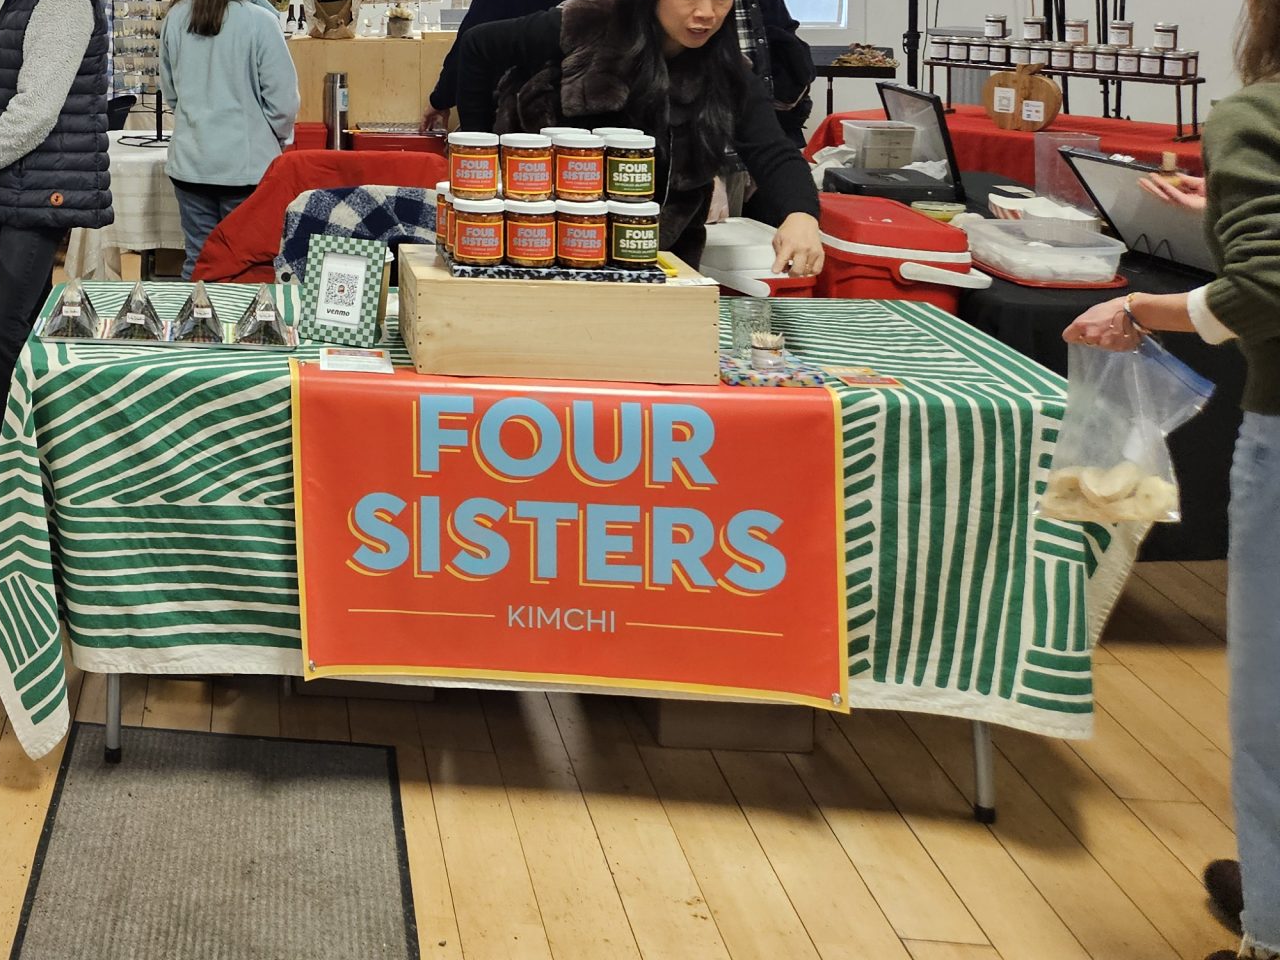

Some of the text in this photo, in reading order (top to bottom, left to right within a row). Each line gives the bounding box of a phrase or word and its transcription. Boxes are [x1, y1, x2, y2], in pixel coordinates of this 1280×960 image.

[461, 160, 489, 169] FOUR
[519, 162, 545, 172] FOUR
[568, 161, 596, 170] FOUR
[619, 164, 648, 172] FOUR
[456, 169, 493, 179] SISTERS
[513, 172, 549, 181] SISTERS
[562, 171, 600, 180] SISTERS
[613, 173, 652, 182] SISTERS
[466, 228, 494, 237] FOUR
[518, 228, 546, 237] FOUR
[567, 228, 597, 238] FOUR
[626, 230, 654, 239] FOUR
[461, 237, 499, 246] SISTERS
[513, 238, 551, 247] SISTERS
[562, 238, 602, 248] SISTERS
[619, 239, 657, 249] SISTERS
[326, 308, 350, 317] venmo
[412, 394, 718, 491] FOUR
[346, 492, 787, 598] SISTERS
[508, 605, 616, 633] KIMCHI
